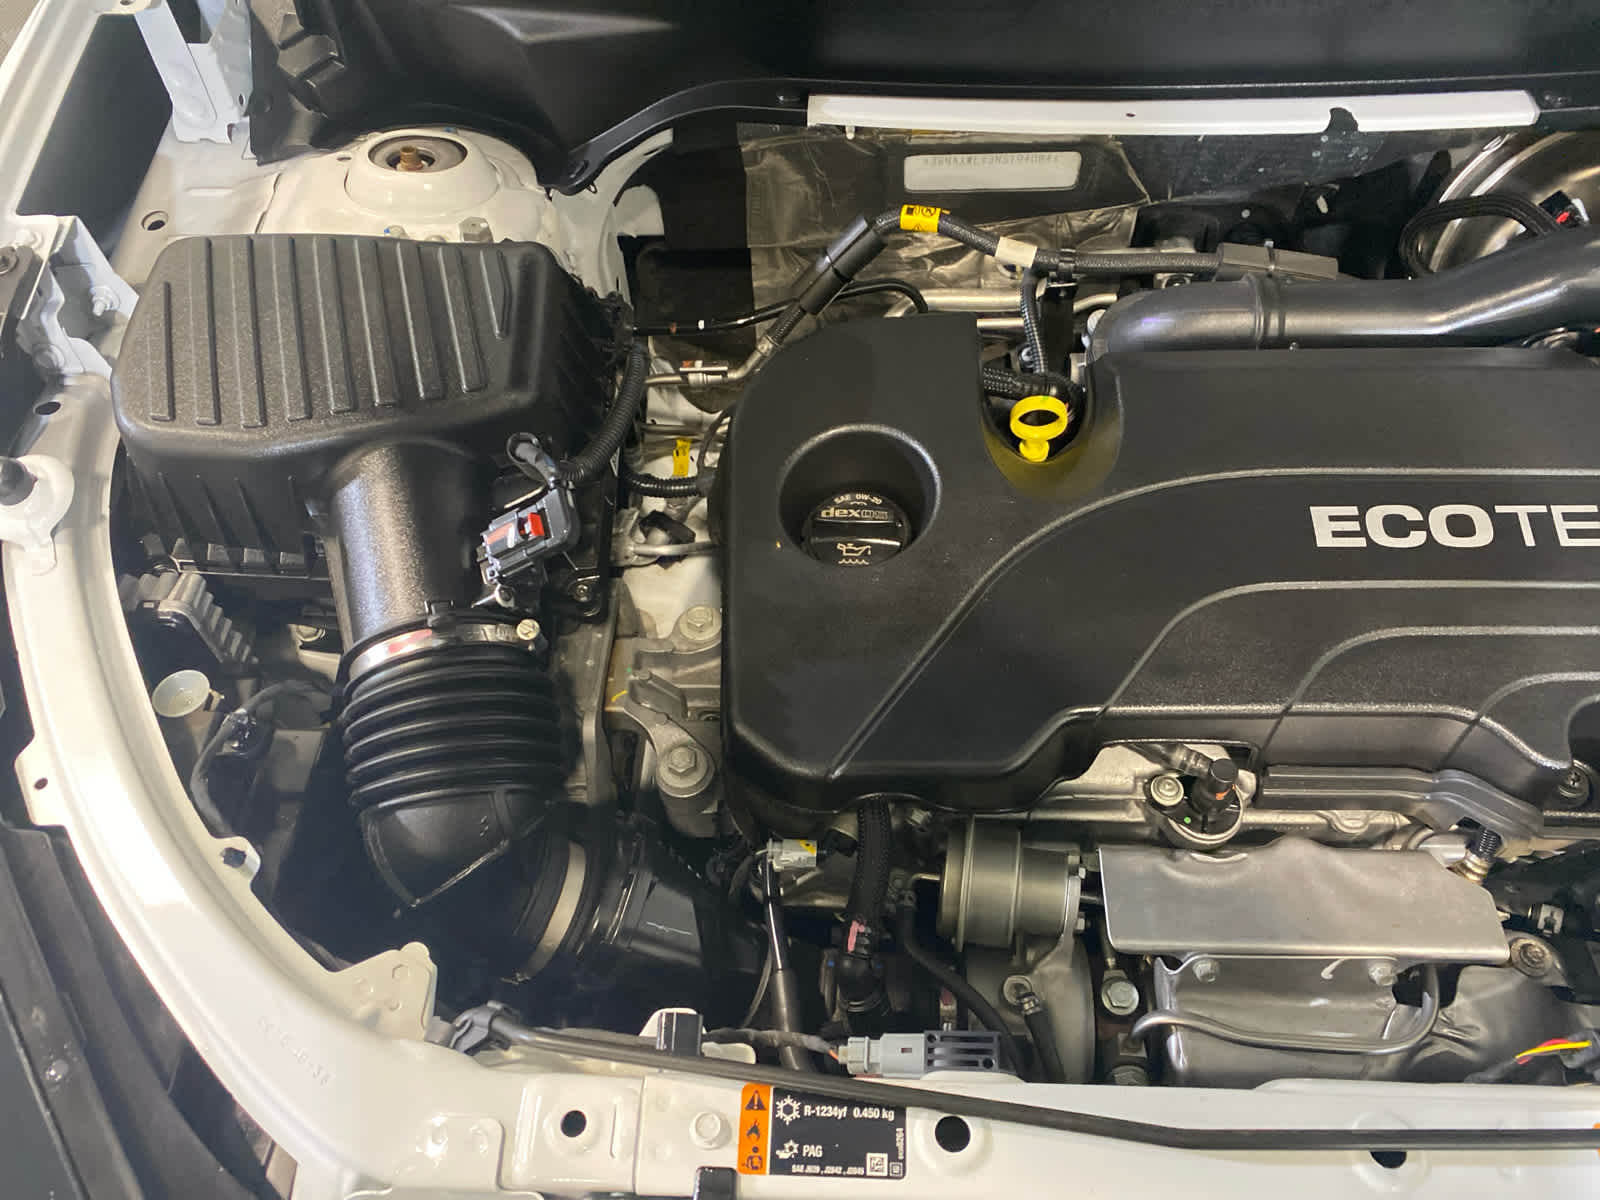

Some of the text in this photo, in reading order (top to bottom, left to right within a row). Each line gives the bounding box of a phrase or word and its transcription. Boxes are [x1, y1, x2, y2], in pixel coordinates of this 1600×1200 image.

[833, 493, 883, 505] SAE 0W-20
[804, 1105, 895, 1121] R-1234yf 0.450 kg
[802, 1144, 823, 1157] PAG
